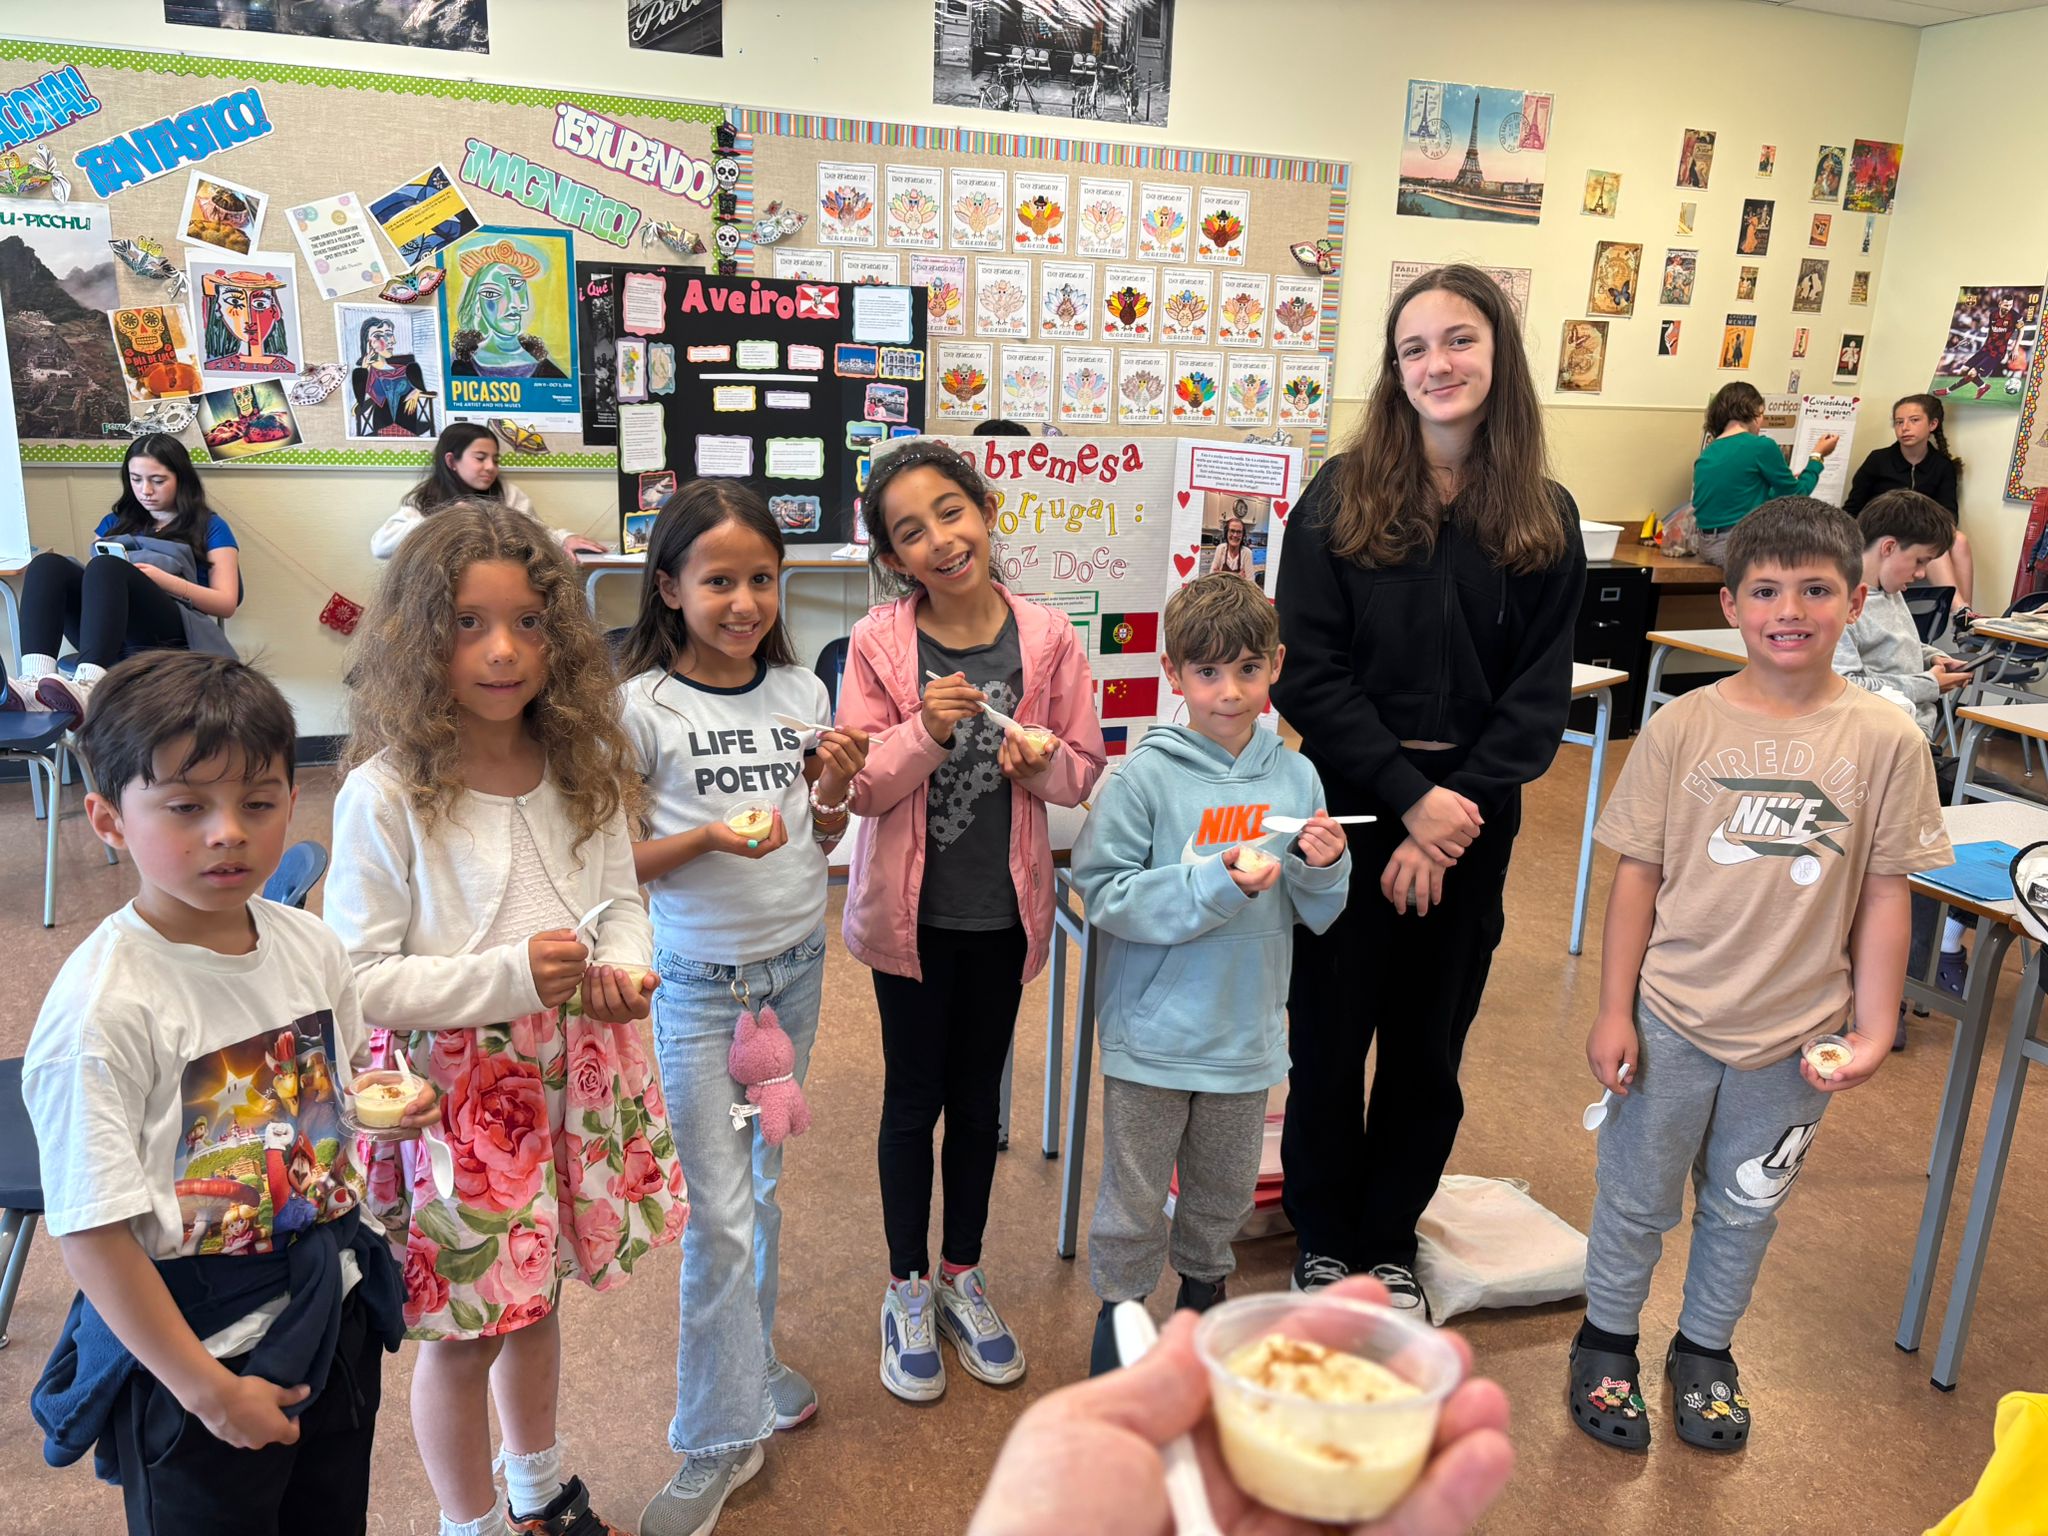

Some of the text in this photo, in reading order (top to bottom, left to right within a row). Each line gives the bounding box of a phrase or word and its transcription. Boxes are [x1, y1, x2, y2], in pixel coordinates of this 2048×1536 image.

[681, 279, 795, 320] Aveiro
[2028, 294, 2039, 304] 10
[452, 381, 521, 402] PICASSO
[933, 440, 1144, 484] obremesa
[1052, 546, 1127, 583] Doce
[688, 727, 801, 756] LIFE IS
[694, 761, 801, 796] POETRY
[1681, 740, 1870, 808] FIRED UP
[1195, 804, 1270, 846] NIKE
[1728, 796, 1824, 836] NIKE
